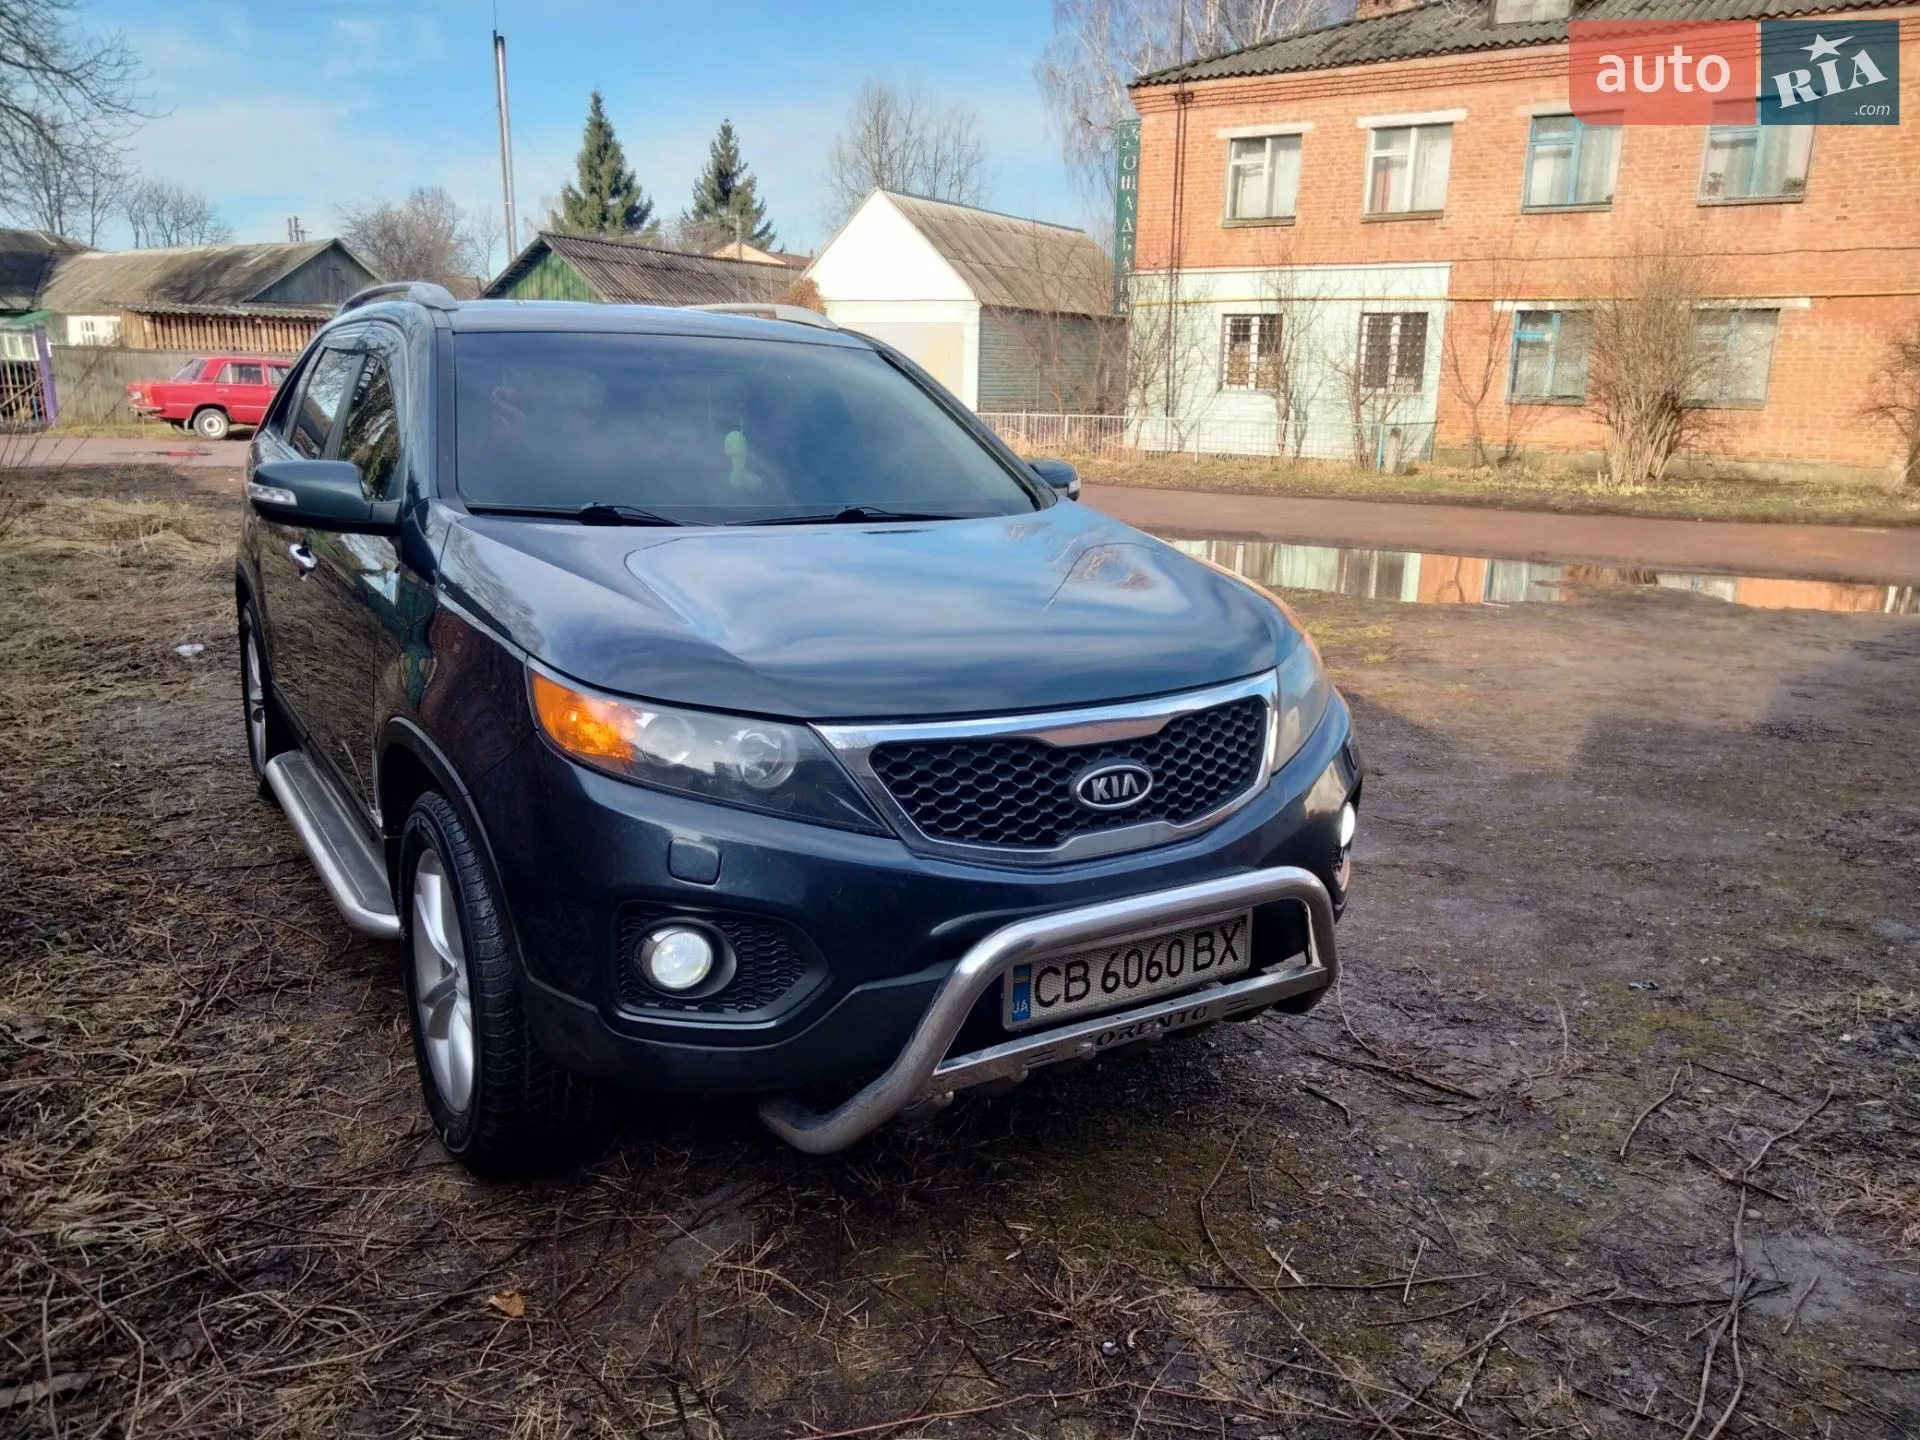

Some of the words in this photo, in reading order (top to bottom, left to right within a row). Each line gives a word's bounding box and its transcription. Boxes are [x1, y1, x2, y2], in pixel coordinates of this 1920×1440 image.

[1091, 773, 1140, 801] KIA
[1034, 960, 1091, 1008] CB
[1101, 938, 1184, 994] 6060
[1193, 921, 1240, 973] BX
[1075, 1005, 1209, 1053] ORENTO
